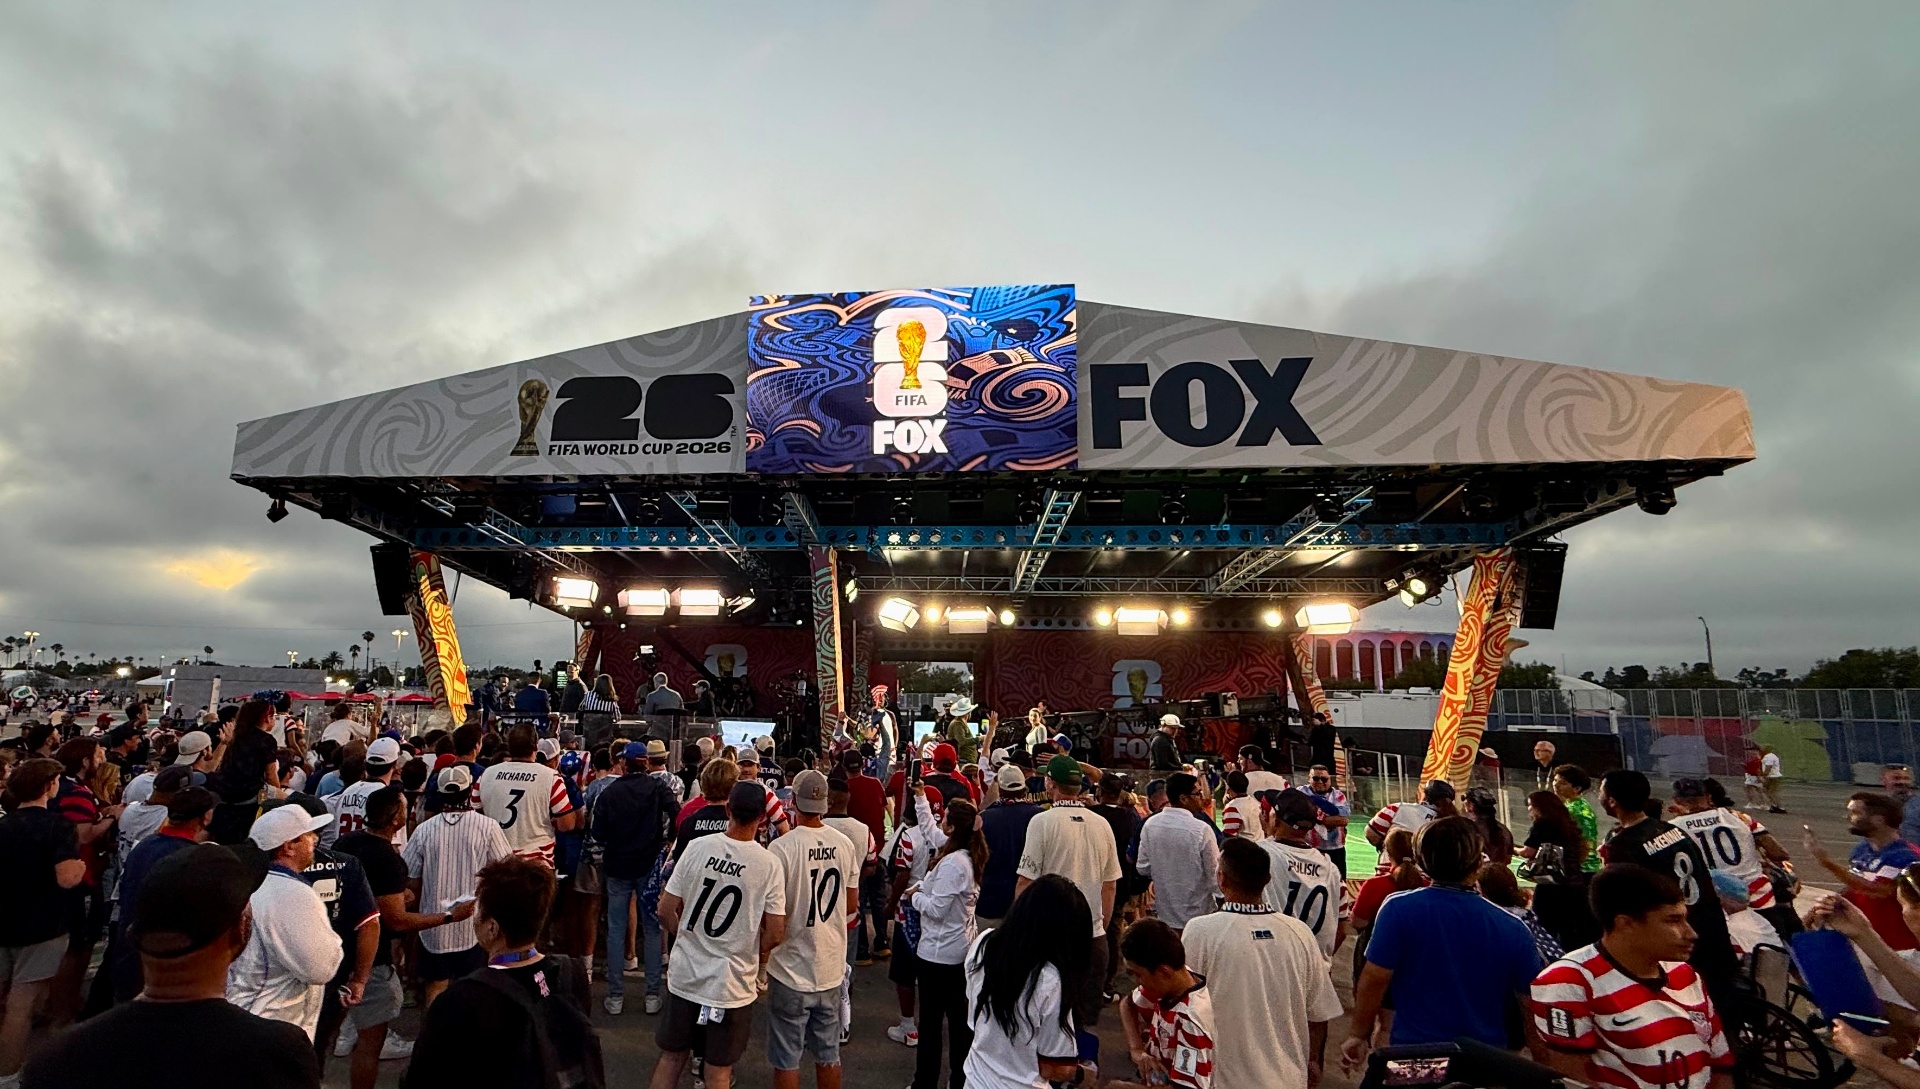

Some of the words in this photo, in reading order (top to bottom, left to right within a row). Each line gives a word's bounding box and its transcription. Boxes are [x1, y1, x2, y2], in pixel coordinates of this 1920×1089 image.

[551, 373, 735, 441] 26
[895, 394, 927, 406] FIFA
[1090, 357, 1323, 449] FOX
[548, 444, 580, 456] FIFA
[583, 443, 639, 456] WORLD
[642, 443, 673, 455] CUP
[676, 441, 732, 455] 2026
[873, 419, 949, 454] FOX
[495, 771, 538, 783] RICHARDS
[500, 789, 525, 829] 3
[705, 856, 746, 878] PULISIC
[808, 847, 837, 862] PULISIC
[1694, 826, 1742, 871] 10
[1288, 860, 1322, 878] PULISIC
[1673, 851, 1700, 905] 8
[686, 877, 743, 938] 10
[806, 867, 841, 928] 10
[1222, 901, 1264, 913] WORLD
[1283, 880, 1329, 936] 10
